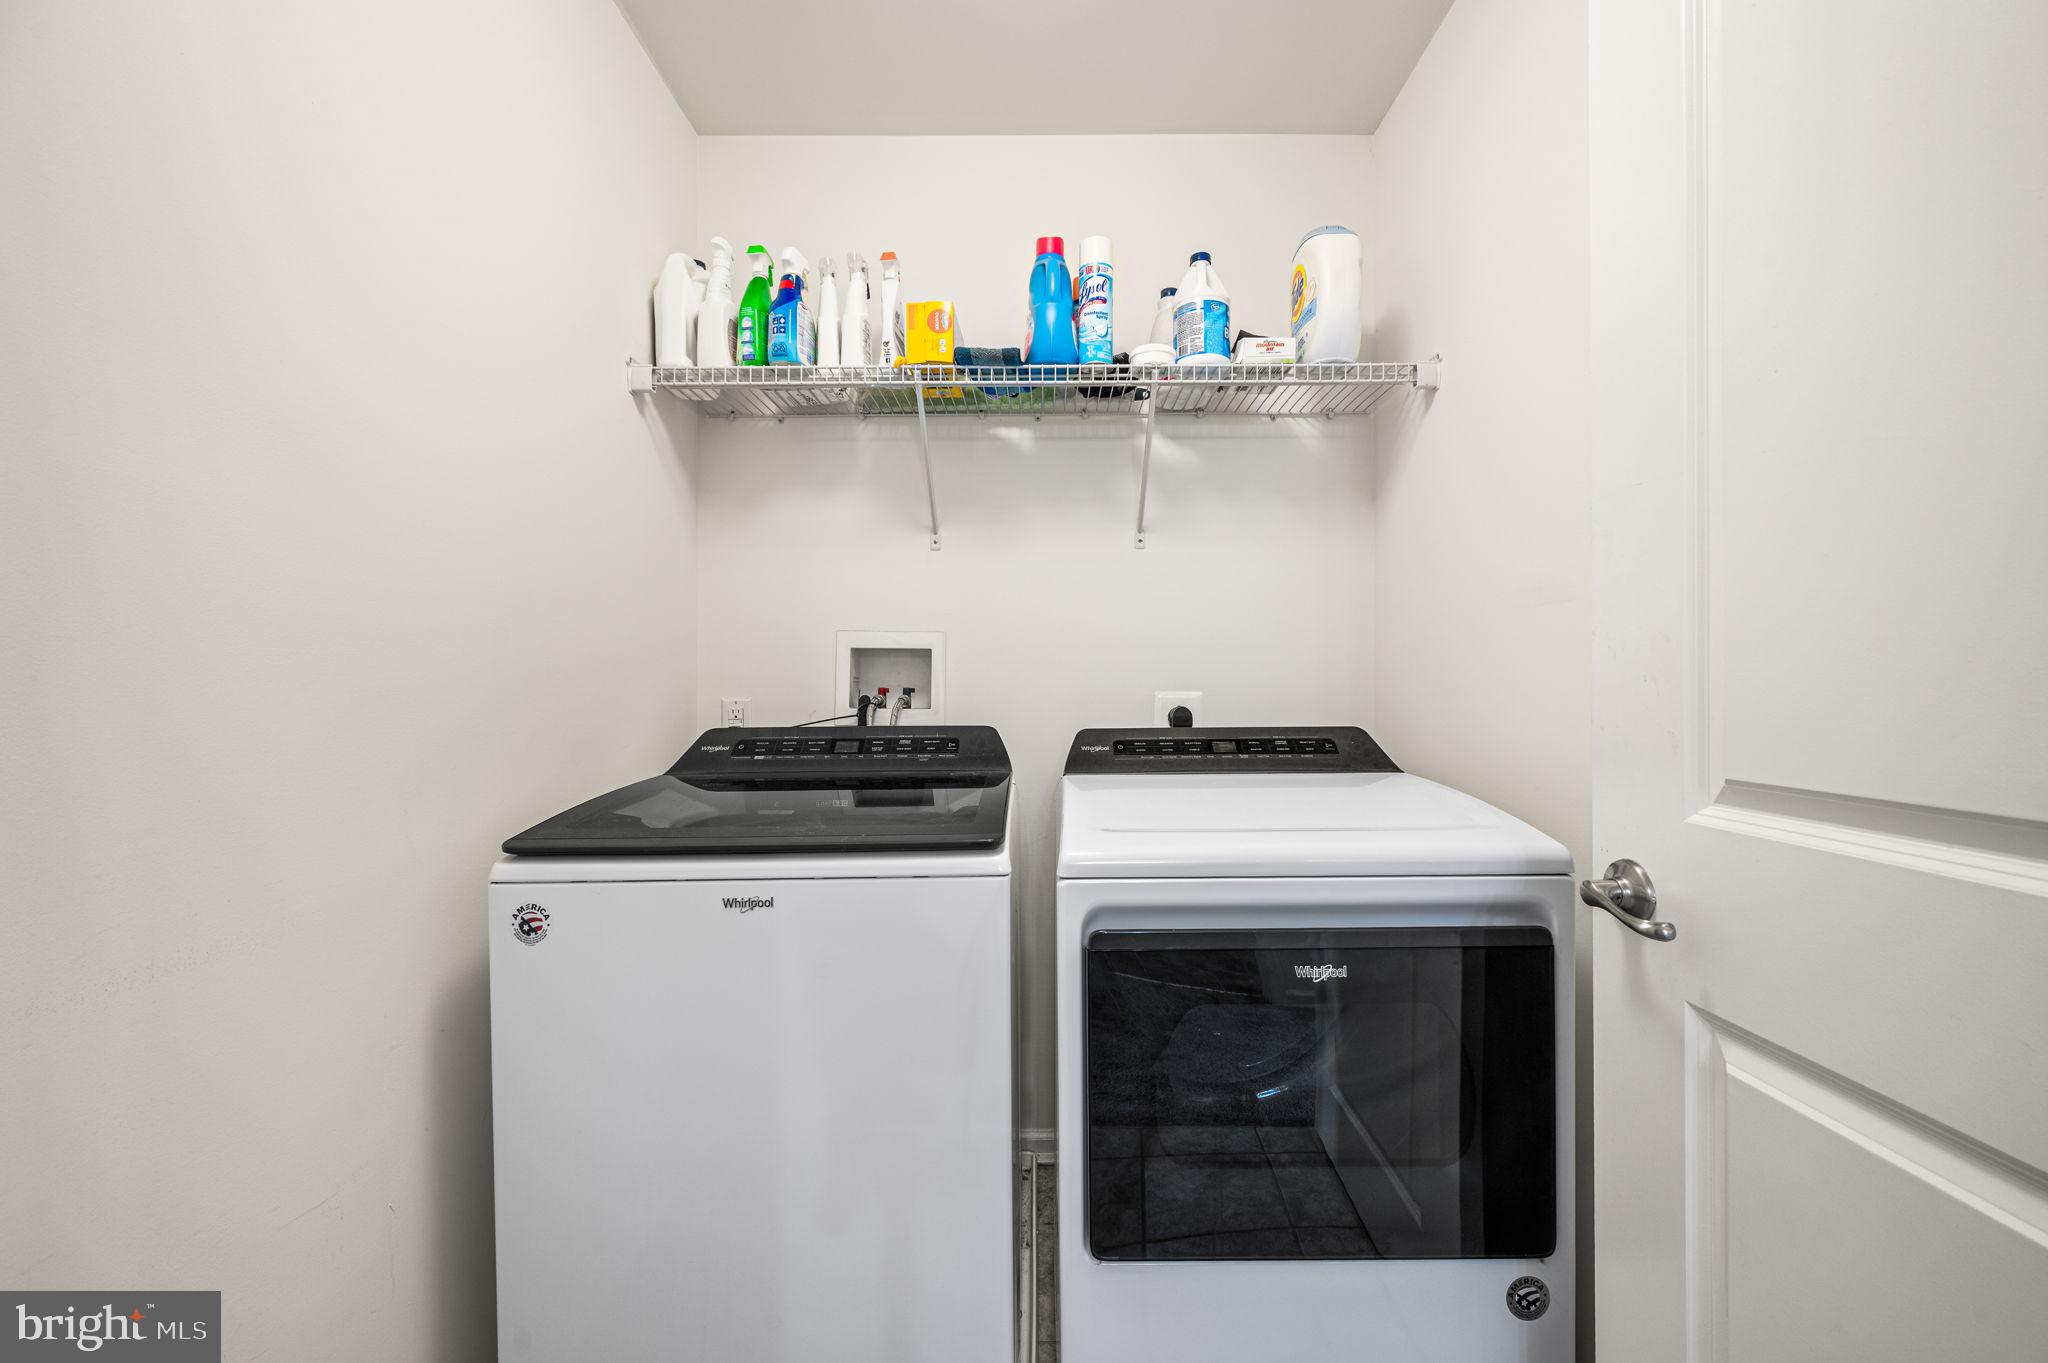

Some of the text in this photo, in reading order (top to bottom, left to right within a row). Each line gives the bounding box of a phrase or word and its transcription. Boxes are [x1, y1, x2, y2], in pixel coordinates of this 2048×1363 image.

[1080, 279, 1107, 305] Lysol
[701, 745, 730, 753] Whirlpool
[1081, 745, 1110, 753] Whirlpool
[512, 903, 550, 920] AMERICA
[722, 896, 774, 913] Whirlpool
[1294, 964, 1348, 983] Whirlpool
[1508, 1278, 1544, 1299] AMERICA
